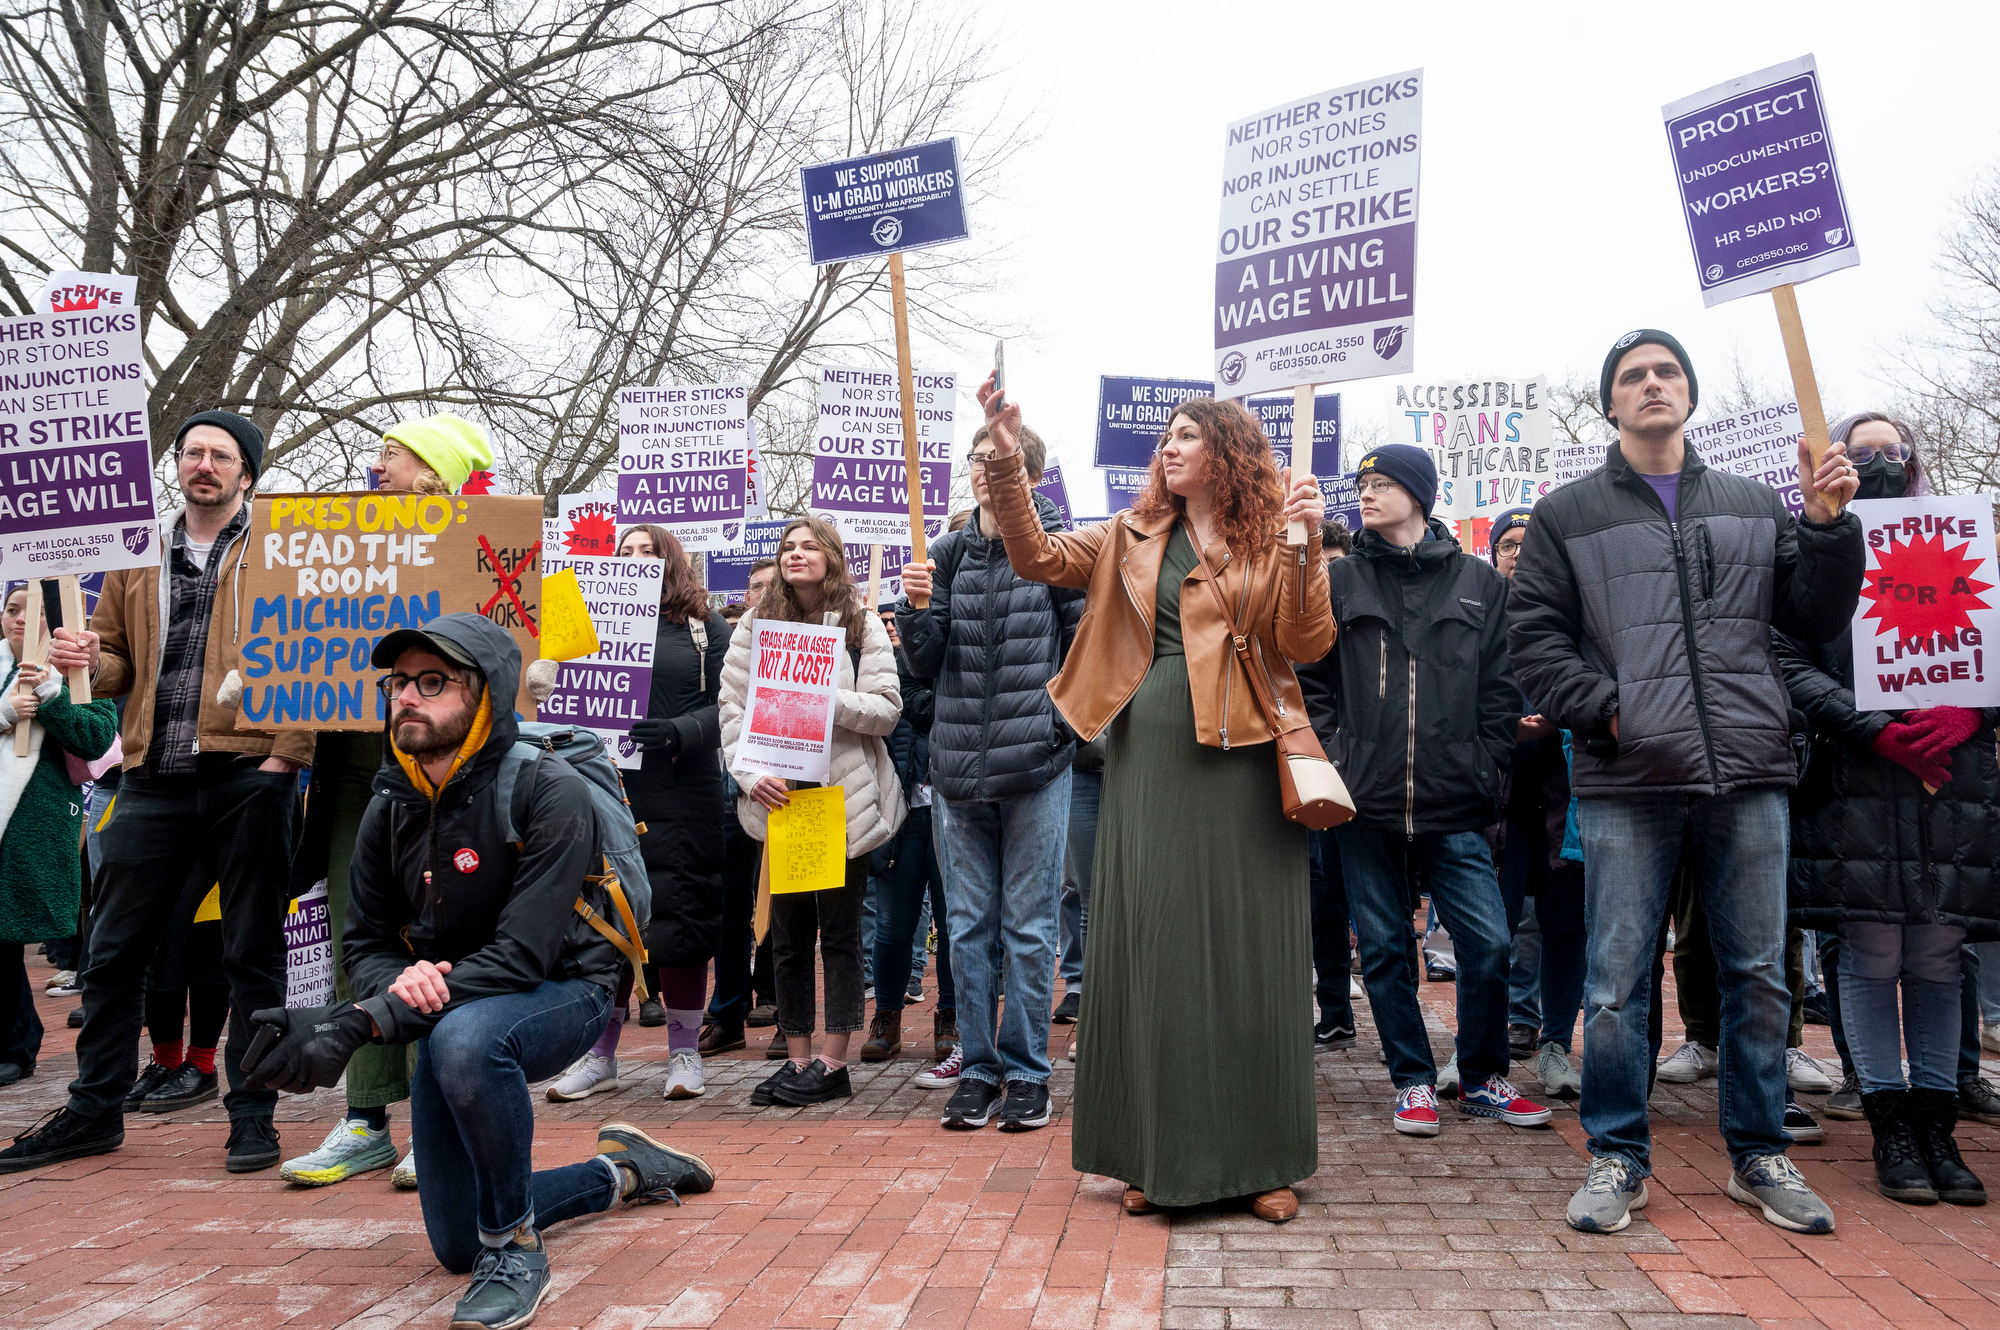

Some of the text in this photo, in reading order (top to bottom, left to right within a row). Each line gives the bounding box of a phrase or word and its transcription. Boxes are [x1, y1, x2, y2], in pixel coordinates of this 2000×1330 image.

[1228, 77, 1418, 146] NEITHER STICKS
[1679, 88, 1808, 149] PROTECT
[1251, 112, 1386, 163] NOR STONES
[1223, 134, 1418, 197] NOR INJUNCTIONS
[1683, 131, 1823, 184] UNDOCUMENTED
[835, 156, 920, 187] WE SUPPORT
[813, 192, 841, 213] U-M
[845, 185, 882, 207] GRAD
[885, 170, 955, 199] WORKERS
[1251, 168, 1379, 214] CAN SETTLE
[1689, 162, 1829, 217] WORKERS?
[818, 210, 843, 221] UNITED
[843, 208, 858, 217] FOR
[858, 203, 884, 214] DIGNITY
[885, 200, 899, 209] AND
[900, 190, 952, 205] AFFORDABILITY
[1220, 188, 1413, 255] OUR STRIKE
[1714, 207, 1822, 248] HR SAID NO!
[1238, 239, 1384, 293] A LIVING
[1736, 243, 1809, 269] GEO3550.ORG
[51, 284, 122, 304] STRIKE
[1219, 272, 1408, 332] WAGE WILL
[52, 313, 136, 338] STICKS
[26, 340, 109, 363] STONES
[1255, 336, 1364, 361] AFT-MI LOCAL 3550
[1375, 325, 1409, 356] aft
[1269, 352, 1346, 371] GEO3550.ORG
[0, 363, 140, 392] INJUNCTIONS
[824, 370, 892, 386] NEITHER
[32, 389, 109, 412] SETTLE
[621, 387, 744, 403] NEITHER STICKS
[842, 388, 873, 401] NOR
[1132, 386, 1151, 402] WE
[1397, 382, 1538, 411] ACCESSIBLE
[640, 404, 726, 418] NOR STONES
[820, 404, 851, 416] NOR
[1107, 404, 1171, 422] U-M GRAD
[1740, 402, 1798, 425] STICKS
[29, 411, 143, 445] STRIKE
[621, 419, 745, 435] NOR INJUNCTIONS
[842, 421, 872, 433] CAN
[1405, 411, 1523, 449] TRANS
[1726, 421, 1783, 446] STONES
[642, 435, 724, 449] CAN SETTLE
[818, 436, 865, 455] OUR
[11, 451, 123, 486] LIVING
[621, 449, 744, 470] OUR STRIKE
[832, 462, 848, 479] A
[1734, 451, 1789, 474] SETTLE
[635, 479, 650, 495] A
[657, 474, 729, 494] LIVING
[1110, 474, 1151, 486] U-M GRAD
[66, 482, 149, 513] WILL
[620, 494, 742, 515] WAGE WILL
[816, 482, 946, 506] WAGE WLL
[270, 495, 352, 530] PRES
[568, 502, 617, 520] STRIKE
[873, 519, 897, 527] LOCAL
[12, 534, 114, 552] AFT-MI LOCAL 3550
[125, 526, 154, 552] aft
[573, 534, 599, 549] FOR
[606, 534, 615, 544] A
[854, 527, 906, 535] GEO3550.ORG
[1867, 514, 1978, 548] STRIKE
[28, 547, 100, 562] GEO3550.ORG
[264, 531, 437, 570] READ THE
[477, 548, 541, 573] RIGHT
[297, 565, 397, 597] ROOM
[599, 562, 661, 579] STICKS
[577, 580, 638, 596] STONES
[1878, 576, 1972, 605] FOR A
[250, 590, 441, 635] MICHIGAN
[759, 630, 837, 655] GRADS ARE AN ASSET
[1876, 627, 1982, 665] LIVING
[758, 649, 834, 687] NOT A COST!
[1877, 648, 1985, 693] WAGE!
[243, 679, 364, 724] UNION
[585, 696, 643, 720] WILL
[456, 855, 479, 871] PSL
[314, 1022, 339, 1033] CHROME
